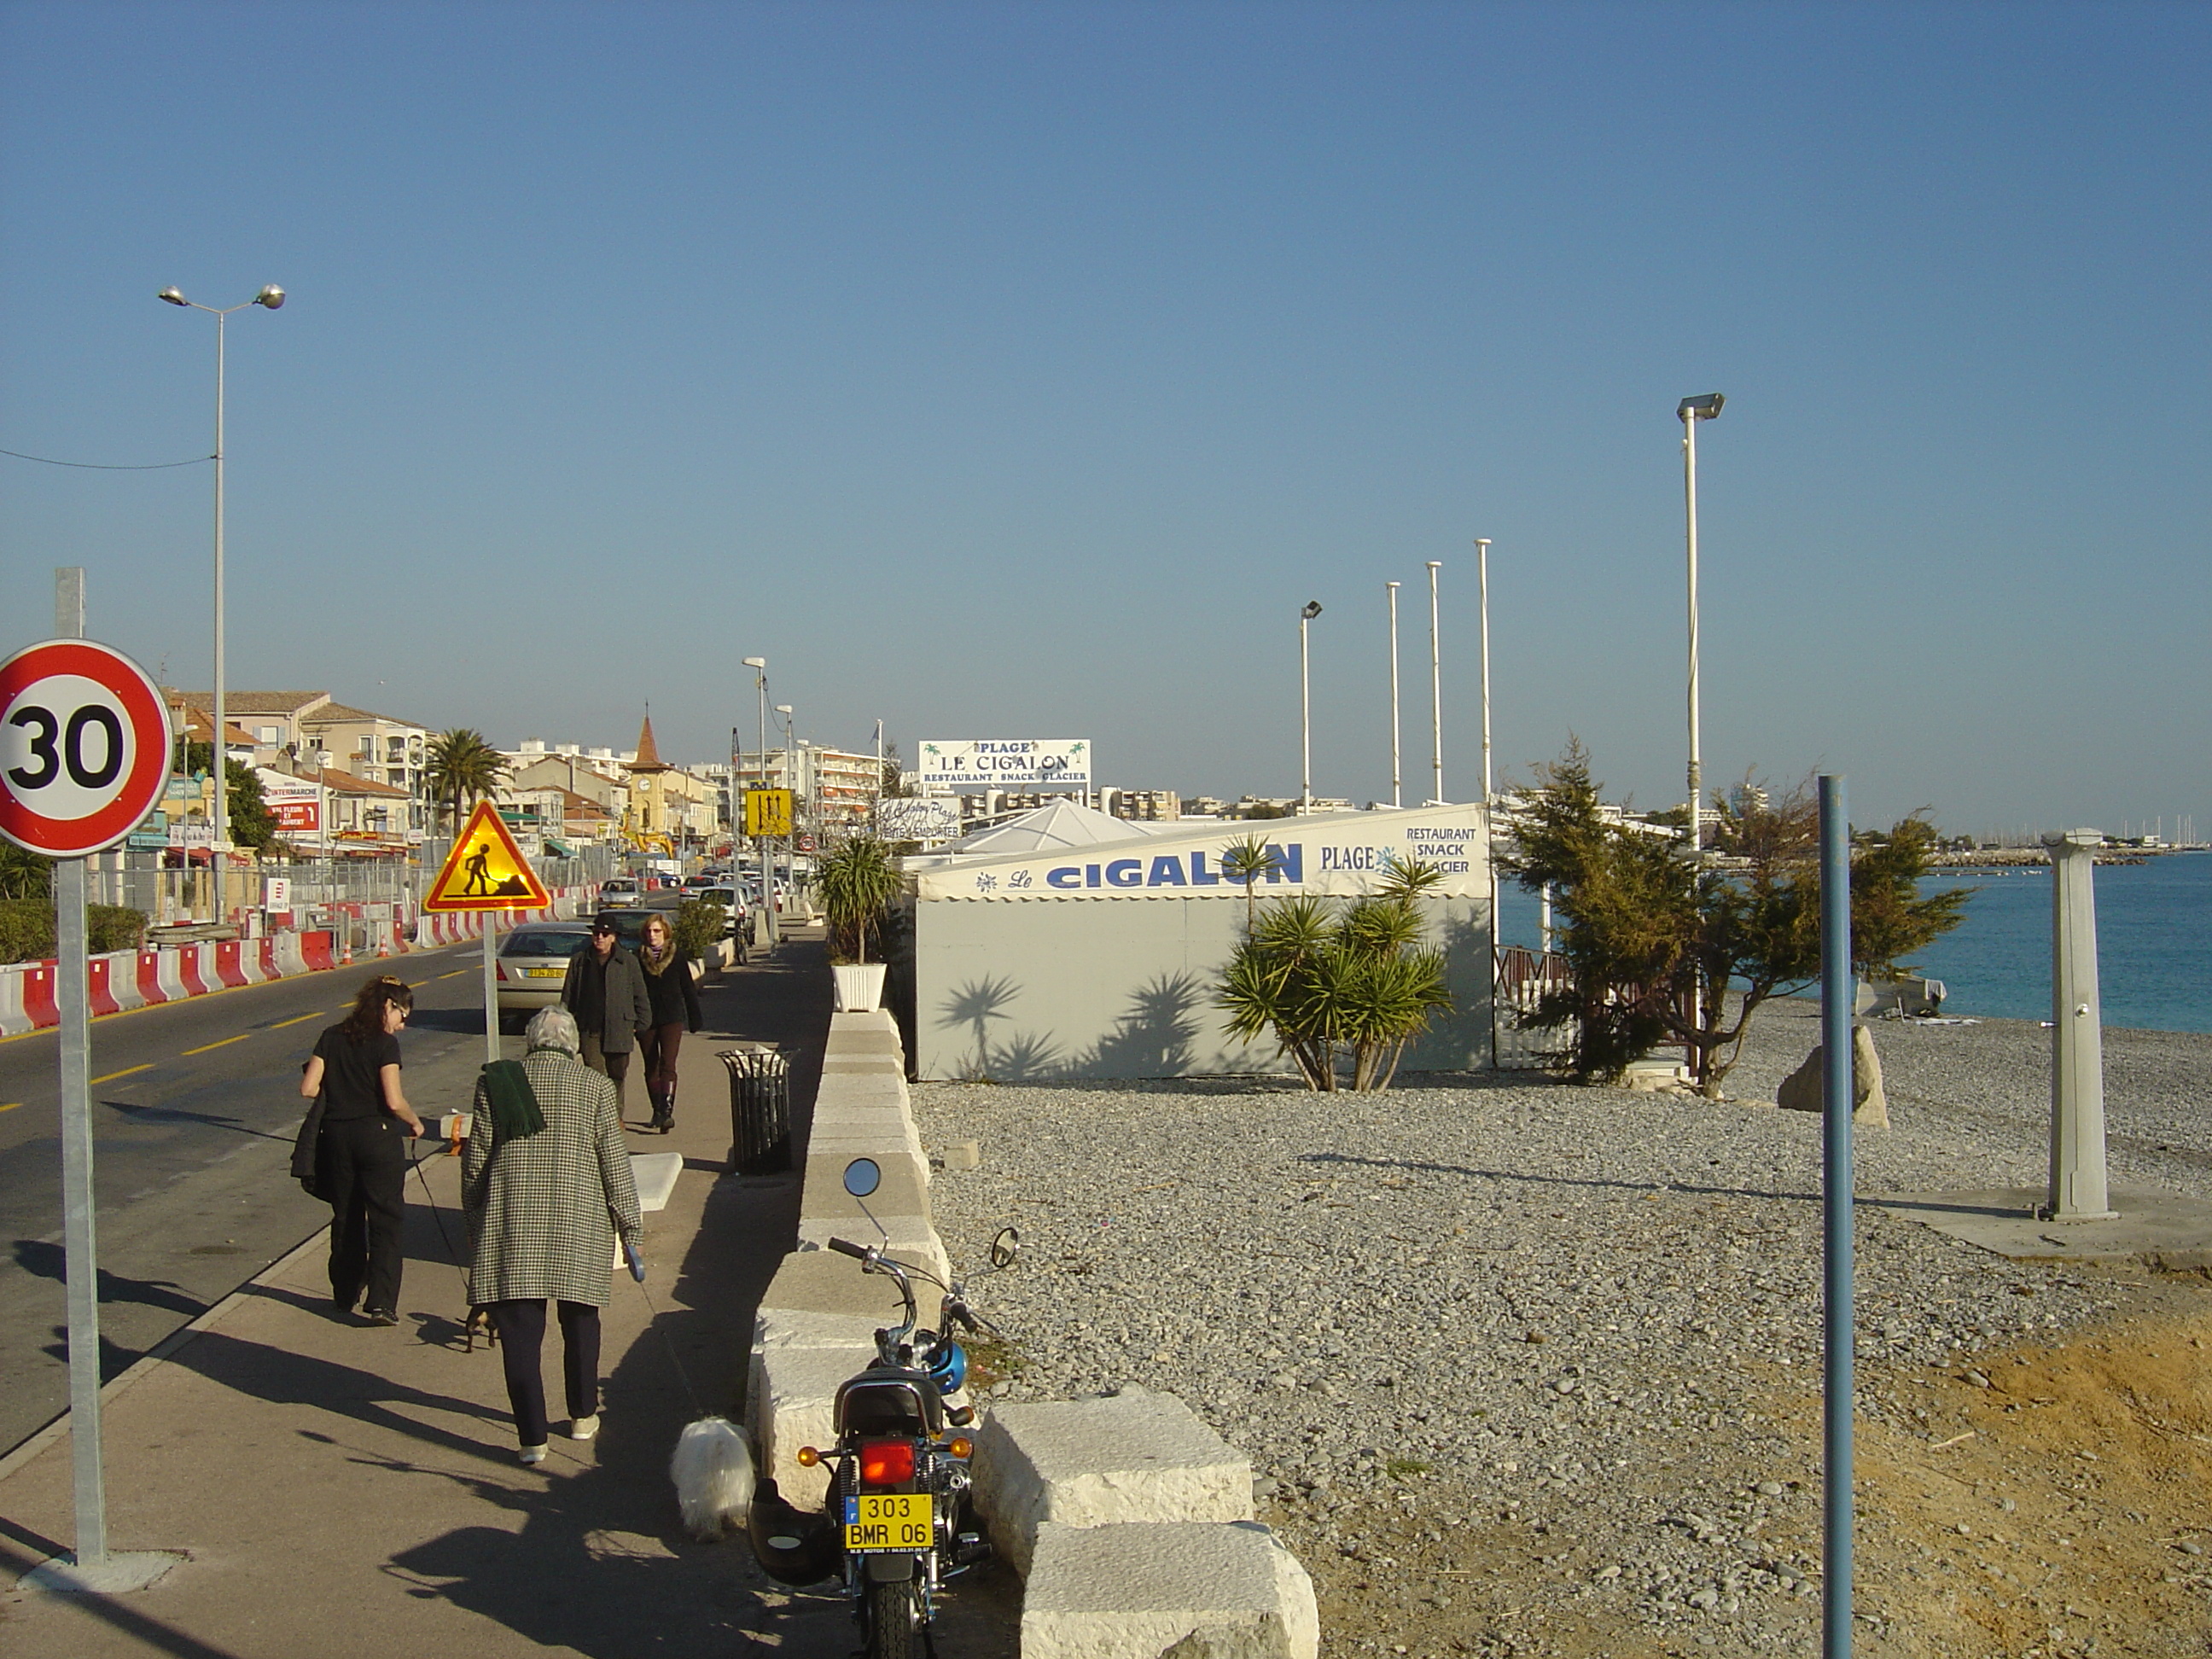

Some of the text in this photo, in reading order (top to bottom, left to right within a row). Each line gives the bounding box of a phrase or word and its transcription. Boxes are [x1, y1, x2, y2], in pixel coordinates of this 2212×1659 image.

[8, 705, 124, 789] 30
[980, 742, 1030, 753] PLAGE
[941, 755, 1069, 771] LE CIGALON
[924, 773, 993, 782] RESTAURANT
[1042, 772, 1086, 781] GLACIER
[307, 806, 315, 822] 1
[1407, 828, 1476, 840] RESTAURANT
[1417, 844, 1464, 856] SNACK
[1008, 843, 1303, 889] Le CIGALON
[1321, 847, 1375, 870] PLAGE
[867, 1498, 911, 1519] 303
[850, 1523, 927, 1545] BMR 06
